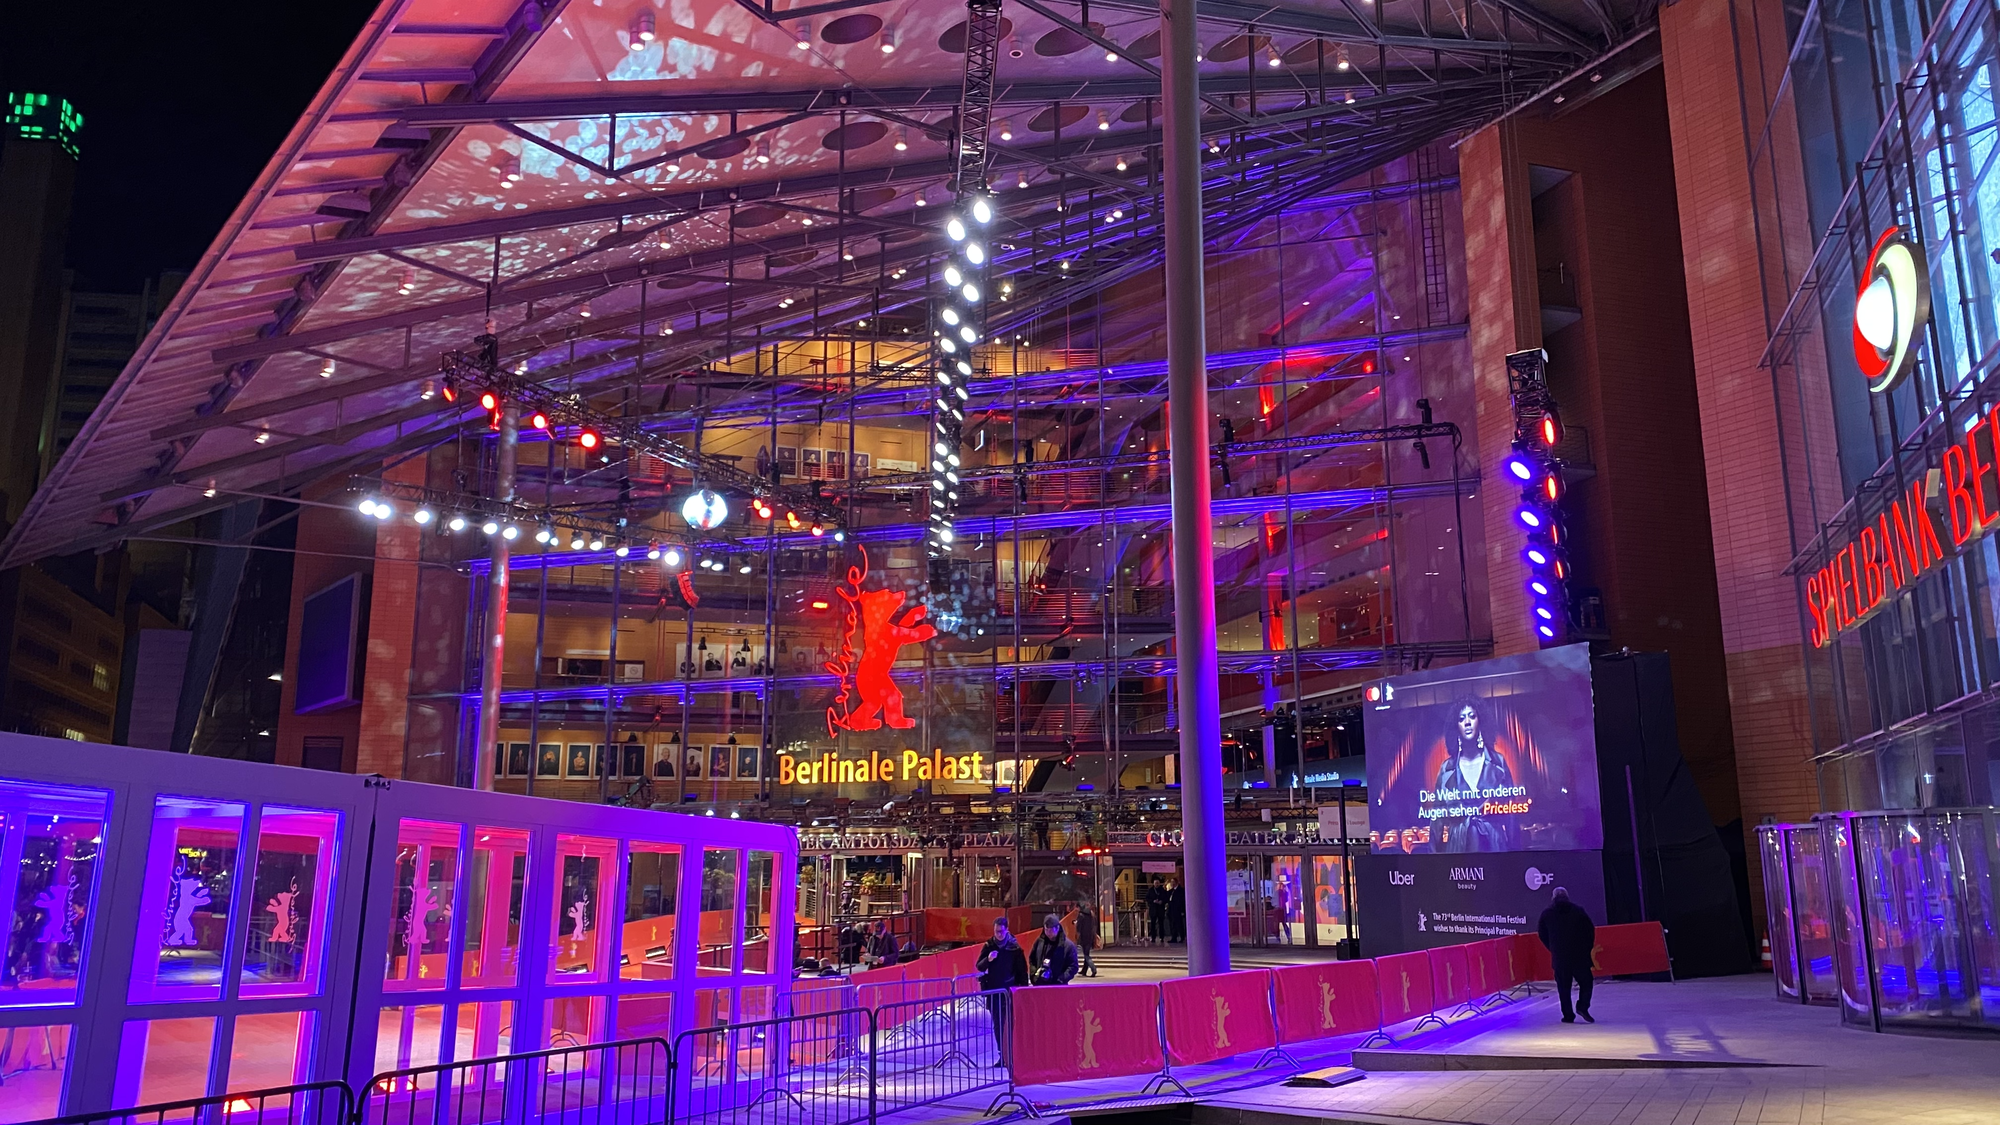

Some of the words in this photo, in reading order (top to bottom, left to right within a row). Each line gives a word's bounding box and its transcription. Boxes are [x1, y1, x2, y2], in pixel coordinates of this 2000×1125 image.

[1807, 471, 1943, 648] SPIELBANK
[779, 750, 895, 785] Berlinale
[902, 748, 983, 781] Palast
[1419, 790, 1436, 802] Die
[1437, 788, 1461, 801] Welt
[1462, 788, 1481, 799] mit
[1482, 784, 1526, 798] anderen
[1418, 807, 1448, 821] Augen
[1449, 804, 1482, 817] sehen.
[1389, 870, 1415, 885] Uber
[1449, 867, 1484, 880] ARMANI
[1433, 912, 1441, 920] The
[1451, 913, 1464, 921] Berlin
[1465, 914, 1495, 923] International
[1495, 915, 1506, 923] Film
[1507, 915, 1527, 924] Festival
[1433, 924, 1448, 932] wishes
[1454, 925, 1468, 933] thank
[1475, 926, 1495, 936] Principal
[1495, 927, 1517, 935] Partners
